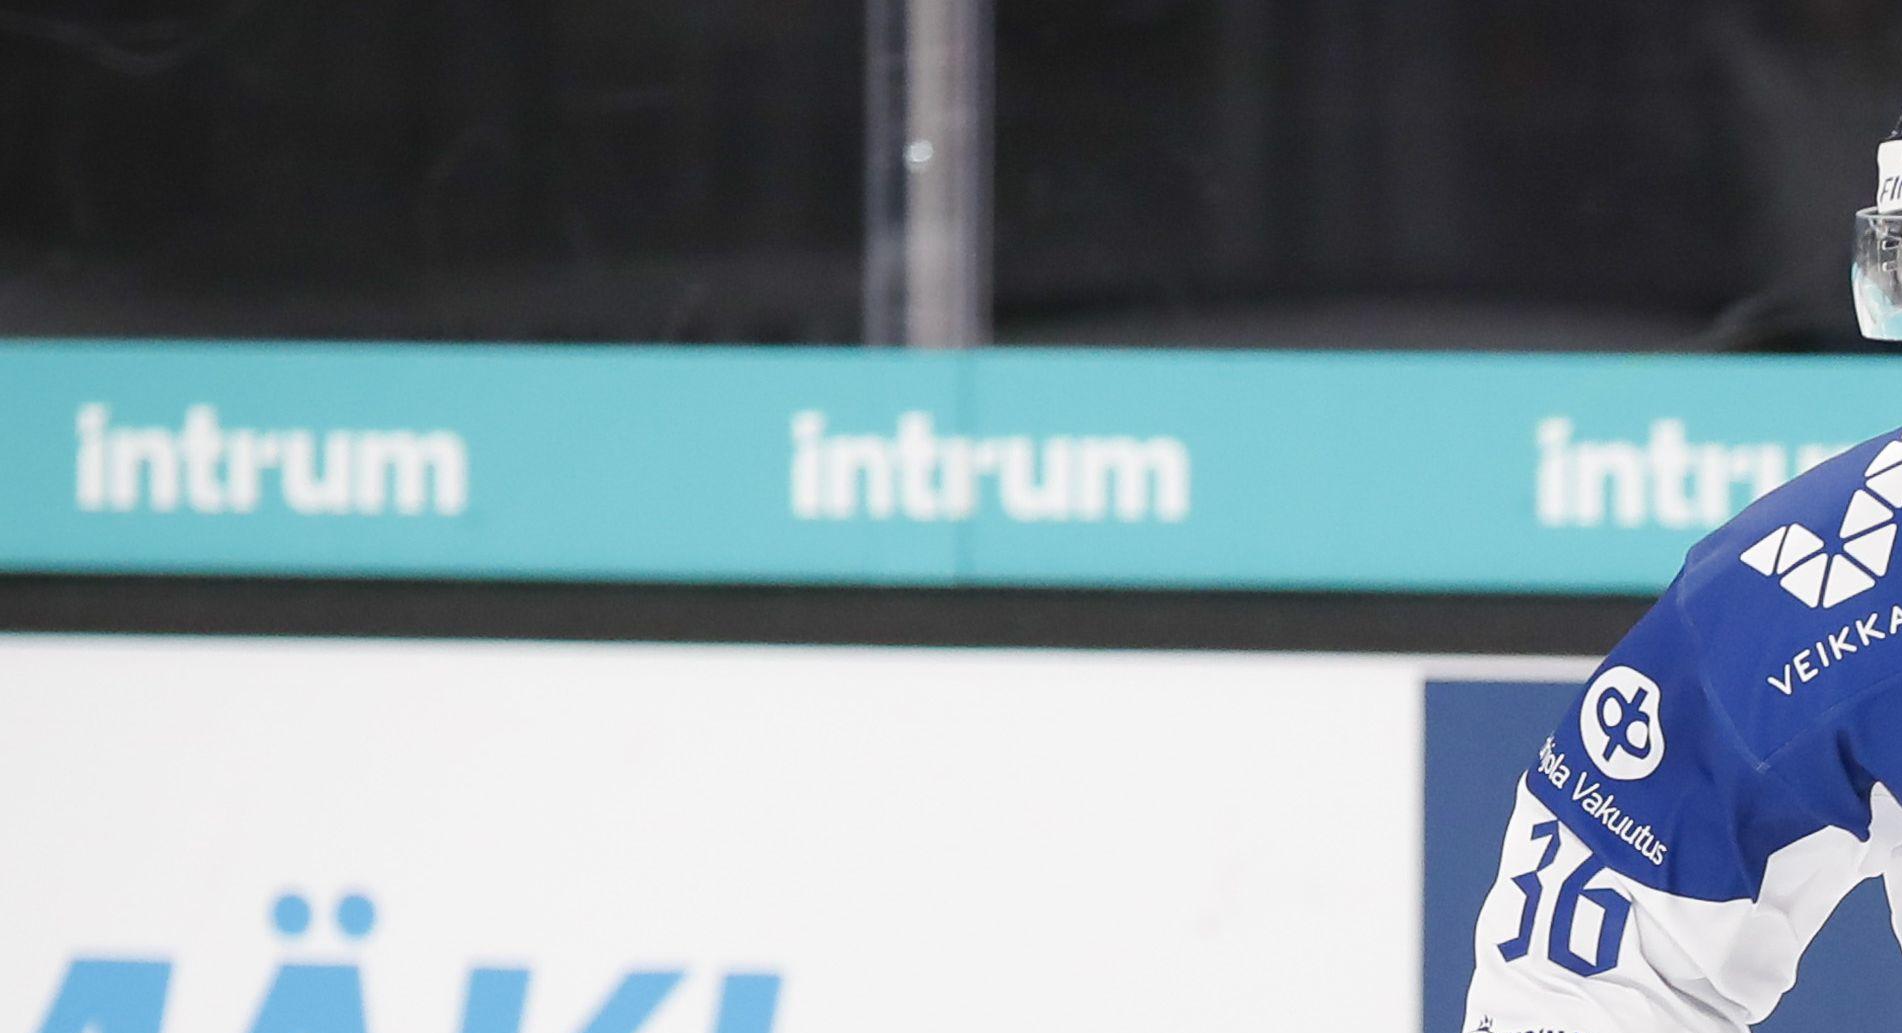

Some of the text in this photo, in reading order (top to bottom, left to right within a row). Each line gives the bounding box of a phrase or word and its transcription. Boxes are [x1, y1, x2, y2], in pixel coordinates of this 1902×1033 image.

[76, 403, 468, 515] intrum
[790, 410, 1190, 522] intrum
[1535, 416, 1852, 530] intr
[1572, 771, 1668, 866] Vakuutus
[1496, 819, 1632, 977] 36
